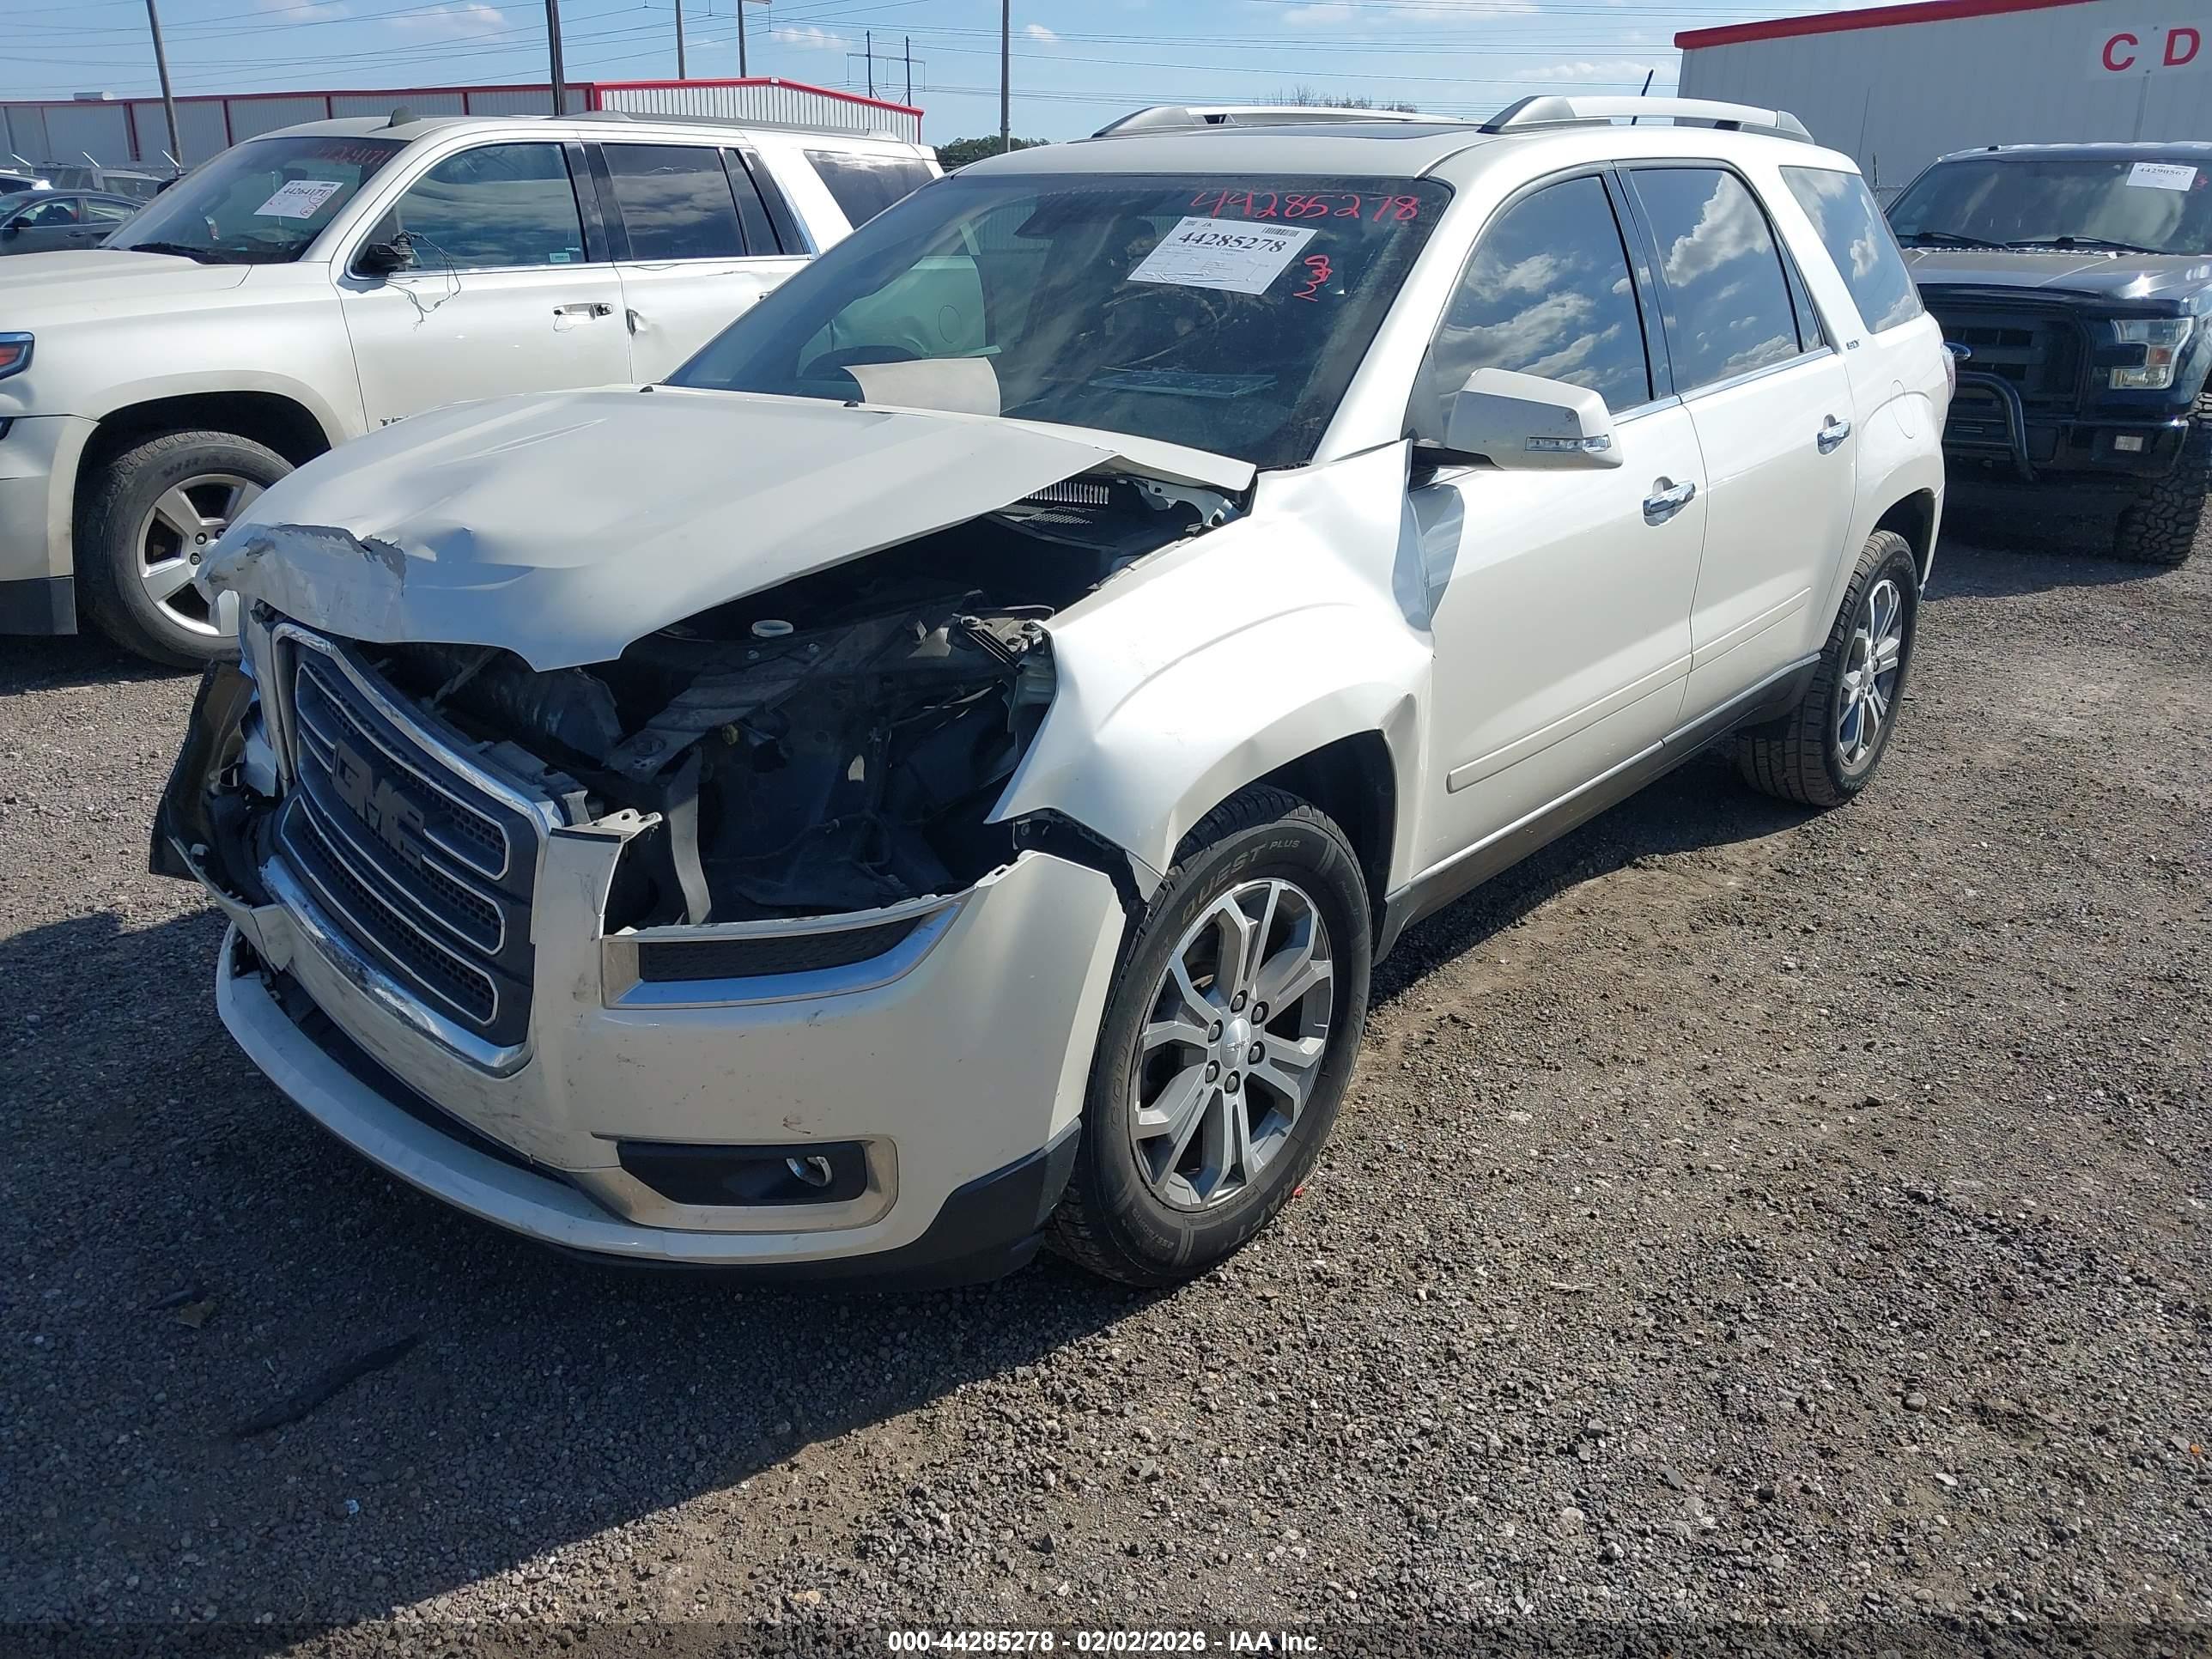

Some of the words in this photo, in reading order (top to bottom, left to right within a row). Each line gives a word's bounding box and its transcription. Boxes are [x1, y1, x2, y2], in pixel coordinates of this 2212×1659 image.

[2102, 33, 2139, 72] C
[2162, 27, 2201, 67] D
[1189, 186, 1419, 223] 44285278
[1177, 230, 1287, 254] 44285278
[331, 737, 426, 872] GMC
[1182, 842, 1268, 926] QUEST
[1268, 839, 1301, 850] PLUS
